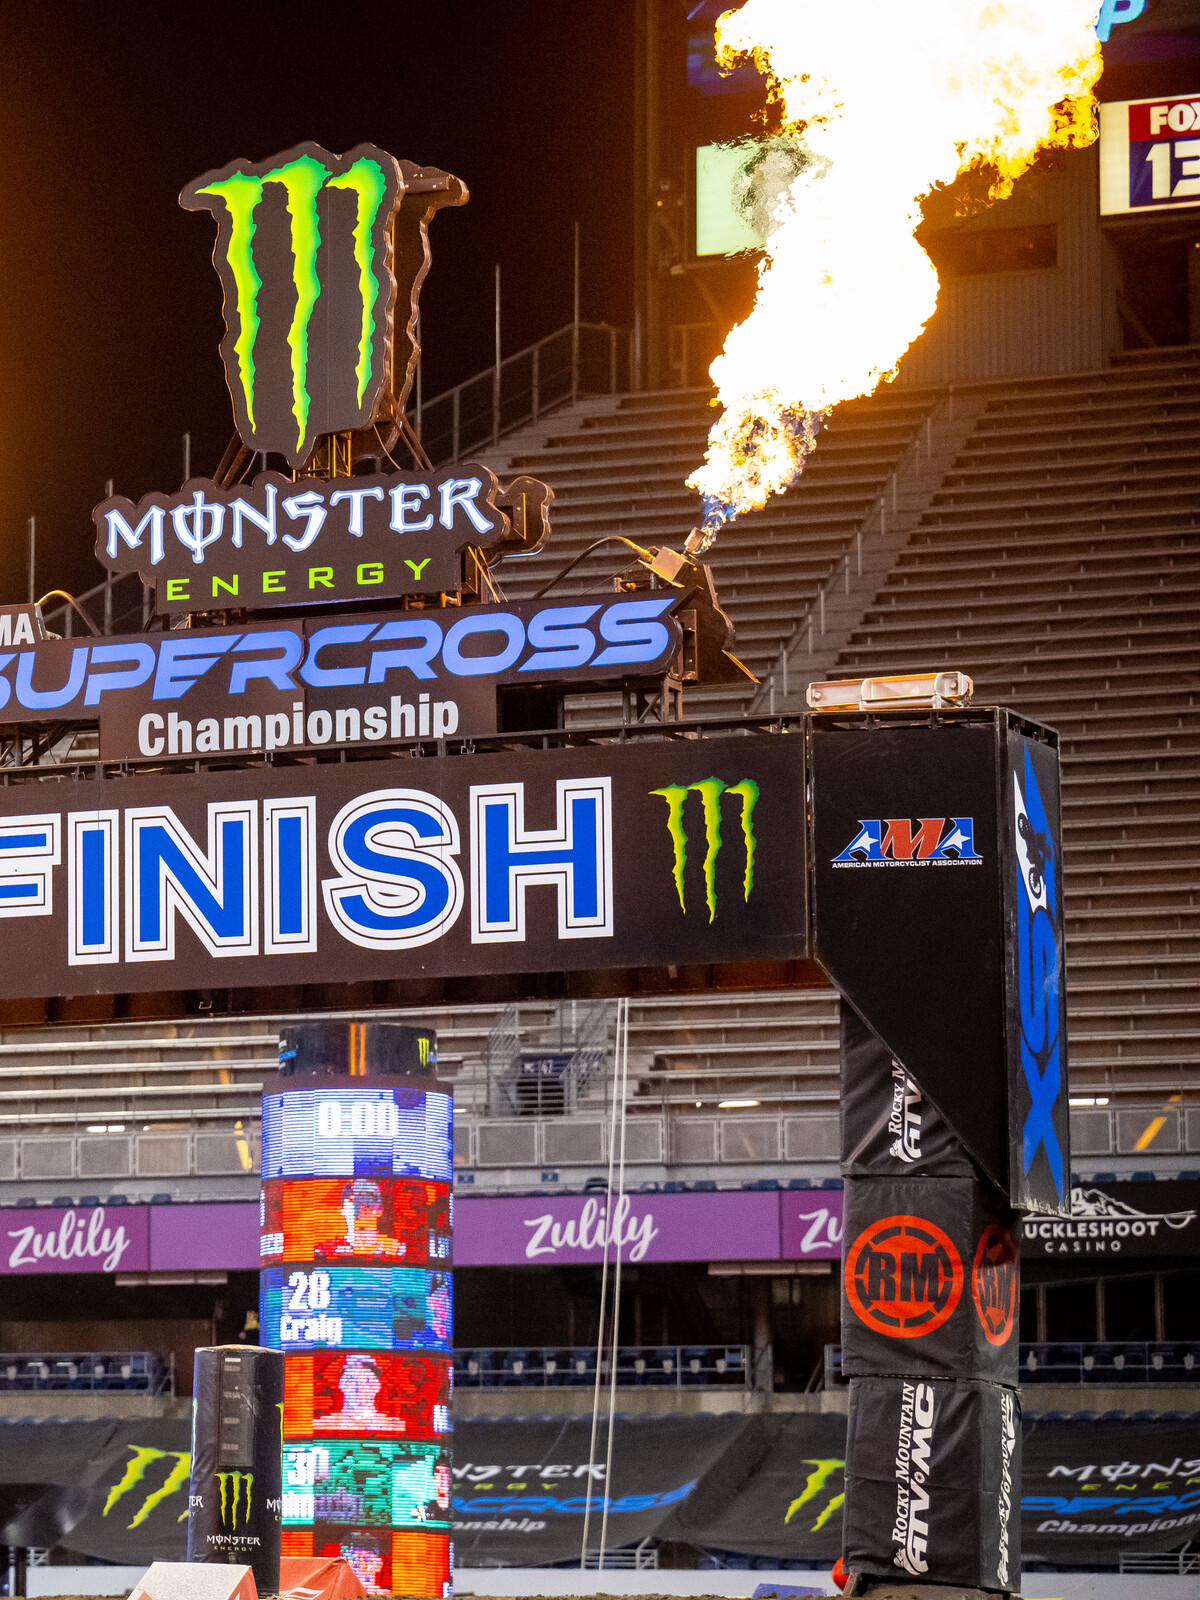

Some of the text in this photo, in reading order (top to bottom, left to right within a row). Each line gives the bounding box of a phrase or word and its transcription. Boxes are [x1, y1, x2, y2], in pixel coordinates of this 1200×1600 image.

[105, 477, 494, 565] MONSTER
[166, 558, 432, 601] ENERGY
[137, 692, 460, 757] Championship
[830, 817, 984, 861] AMA
[889, 1083, 904, 1137] ROCKY
[1020, 1221, 1159, 1239] UCKLESHOOT
[1045, 1240, 1122, 1253] CASINO
[867, 1251, 940, 1302] RM
[892, 1382, 915, 1544] ROCKY MOUNTAIN
[206, 1534, 261, 1546] MONSTER
